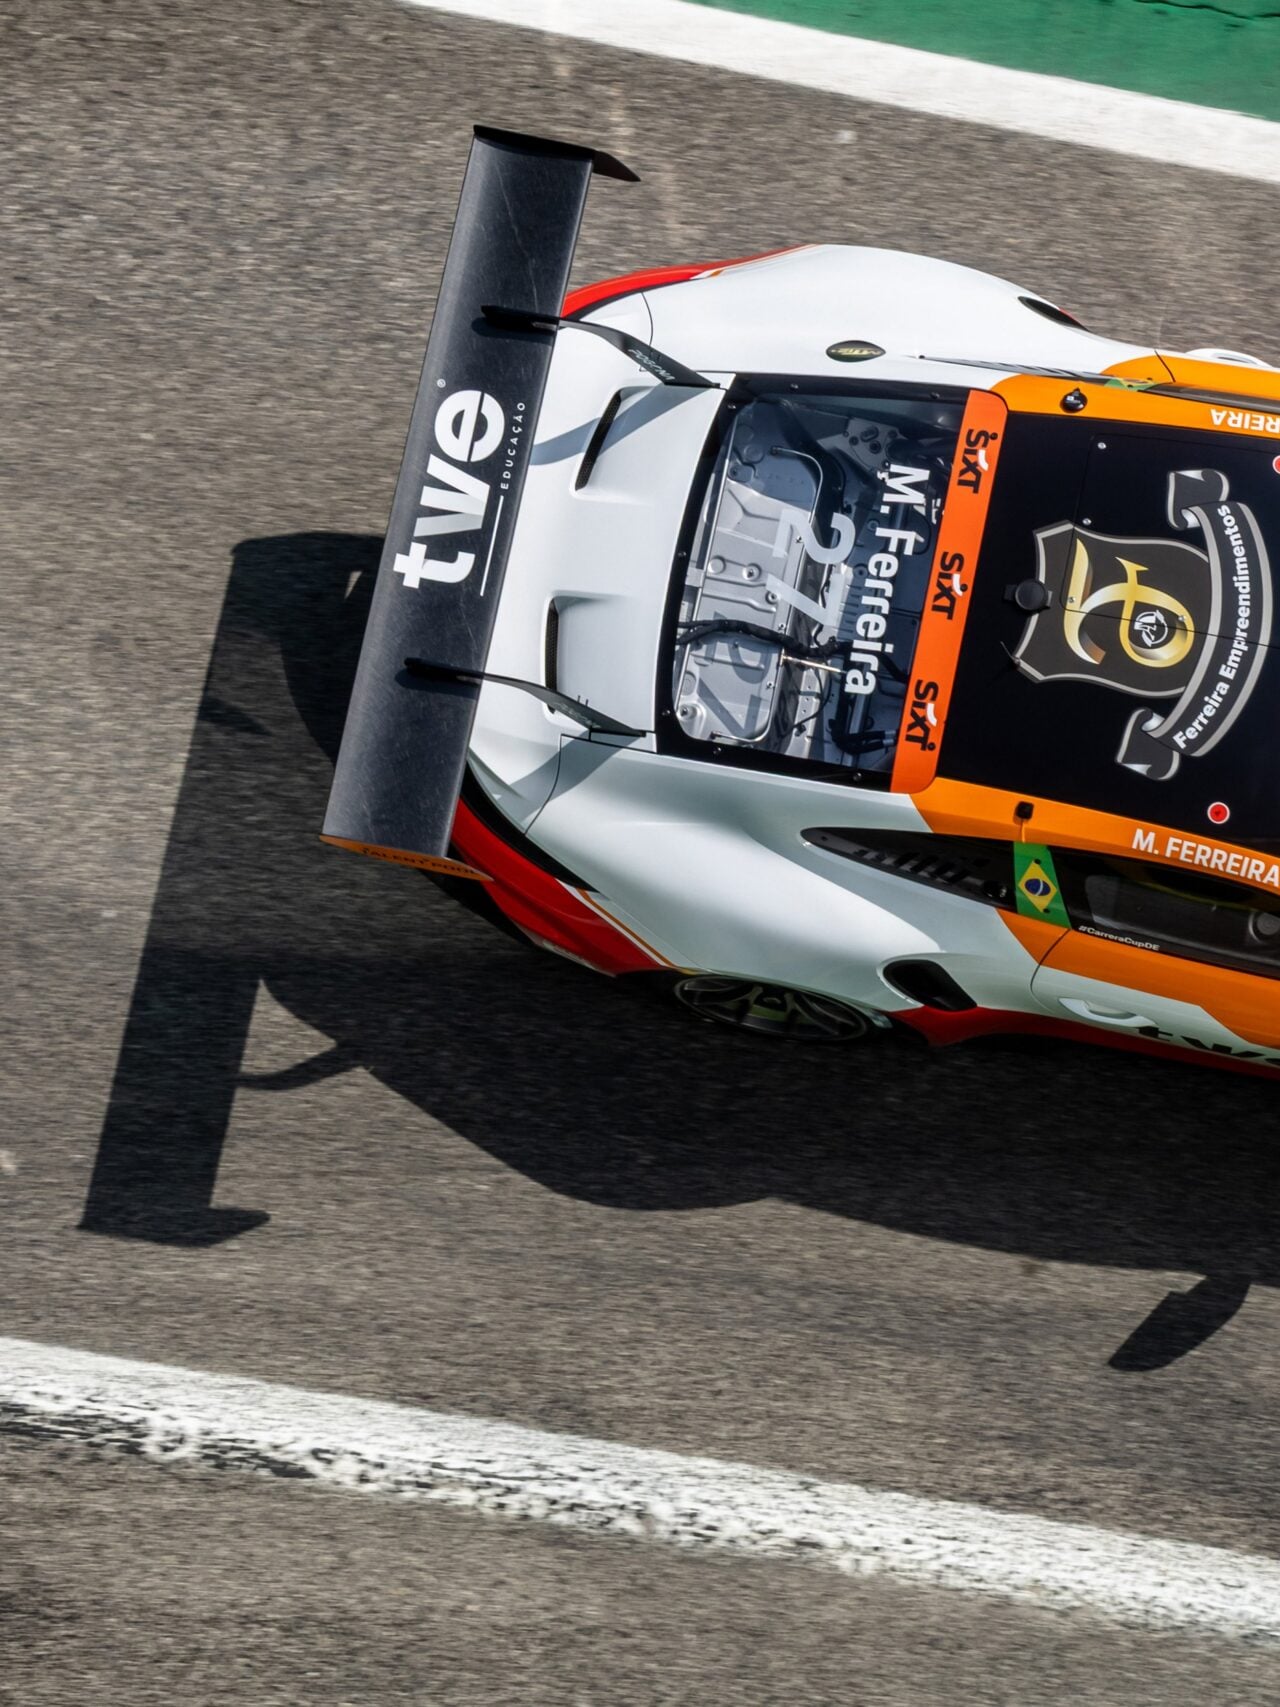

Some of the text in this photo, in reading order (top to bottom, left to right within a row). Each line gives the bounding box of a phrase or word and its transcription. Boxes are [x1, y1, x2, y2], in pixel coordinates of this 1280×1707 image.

[393, 389, 506, 589] tve
[500, 401, 526, 490] EDUCAÇÃO
[766, 508, 856, 627] 27
[844, 463, 931, 695] M. Ferreira
[1172, 504, 1250, 749] Ferreira Empreendimentos
[1131, 828, 1280, 888] M. FERREIRA
[1078, 925, 1161, 951] #CarreraCupDE
